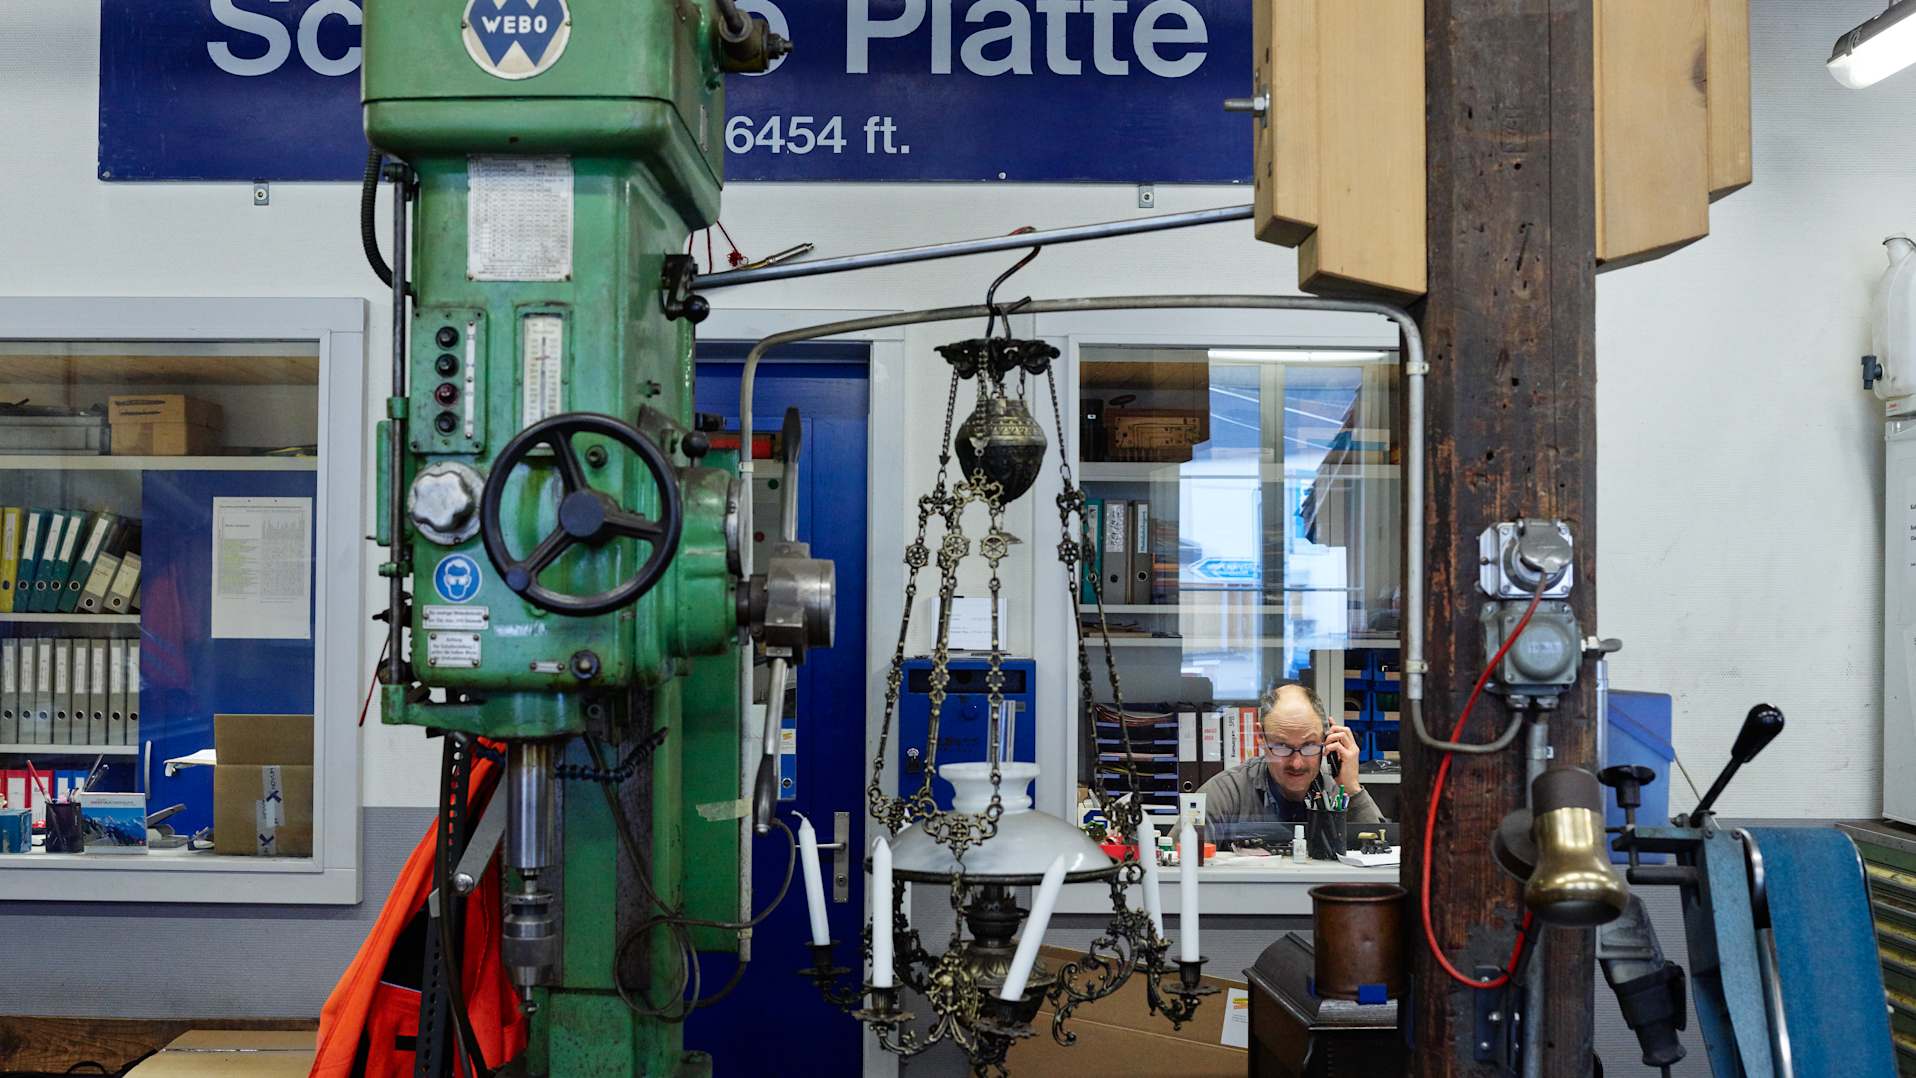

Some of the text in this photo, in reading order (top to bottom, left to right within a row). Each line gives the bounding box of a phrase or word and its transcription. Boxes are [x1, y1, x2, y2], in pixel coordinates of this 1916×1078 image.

[481, 15, 548, 34] WEBO
[846, 0, 1208, 77] Platte
[724, 115, 910, 154] 6454 ft.
